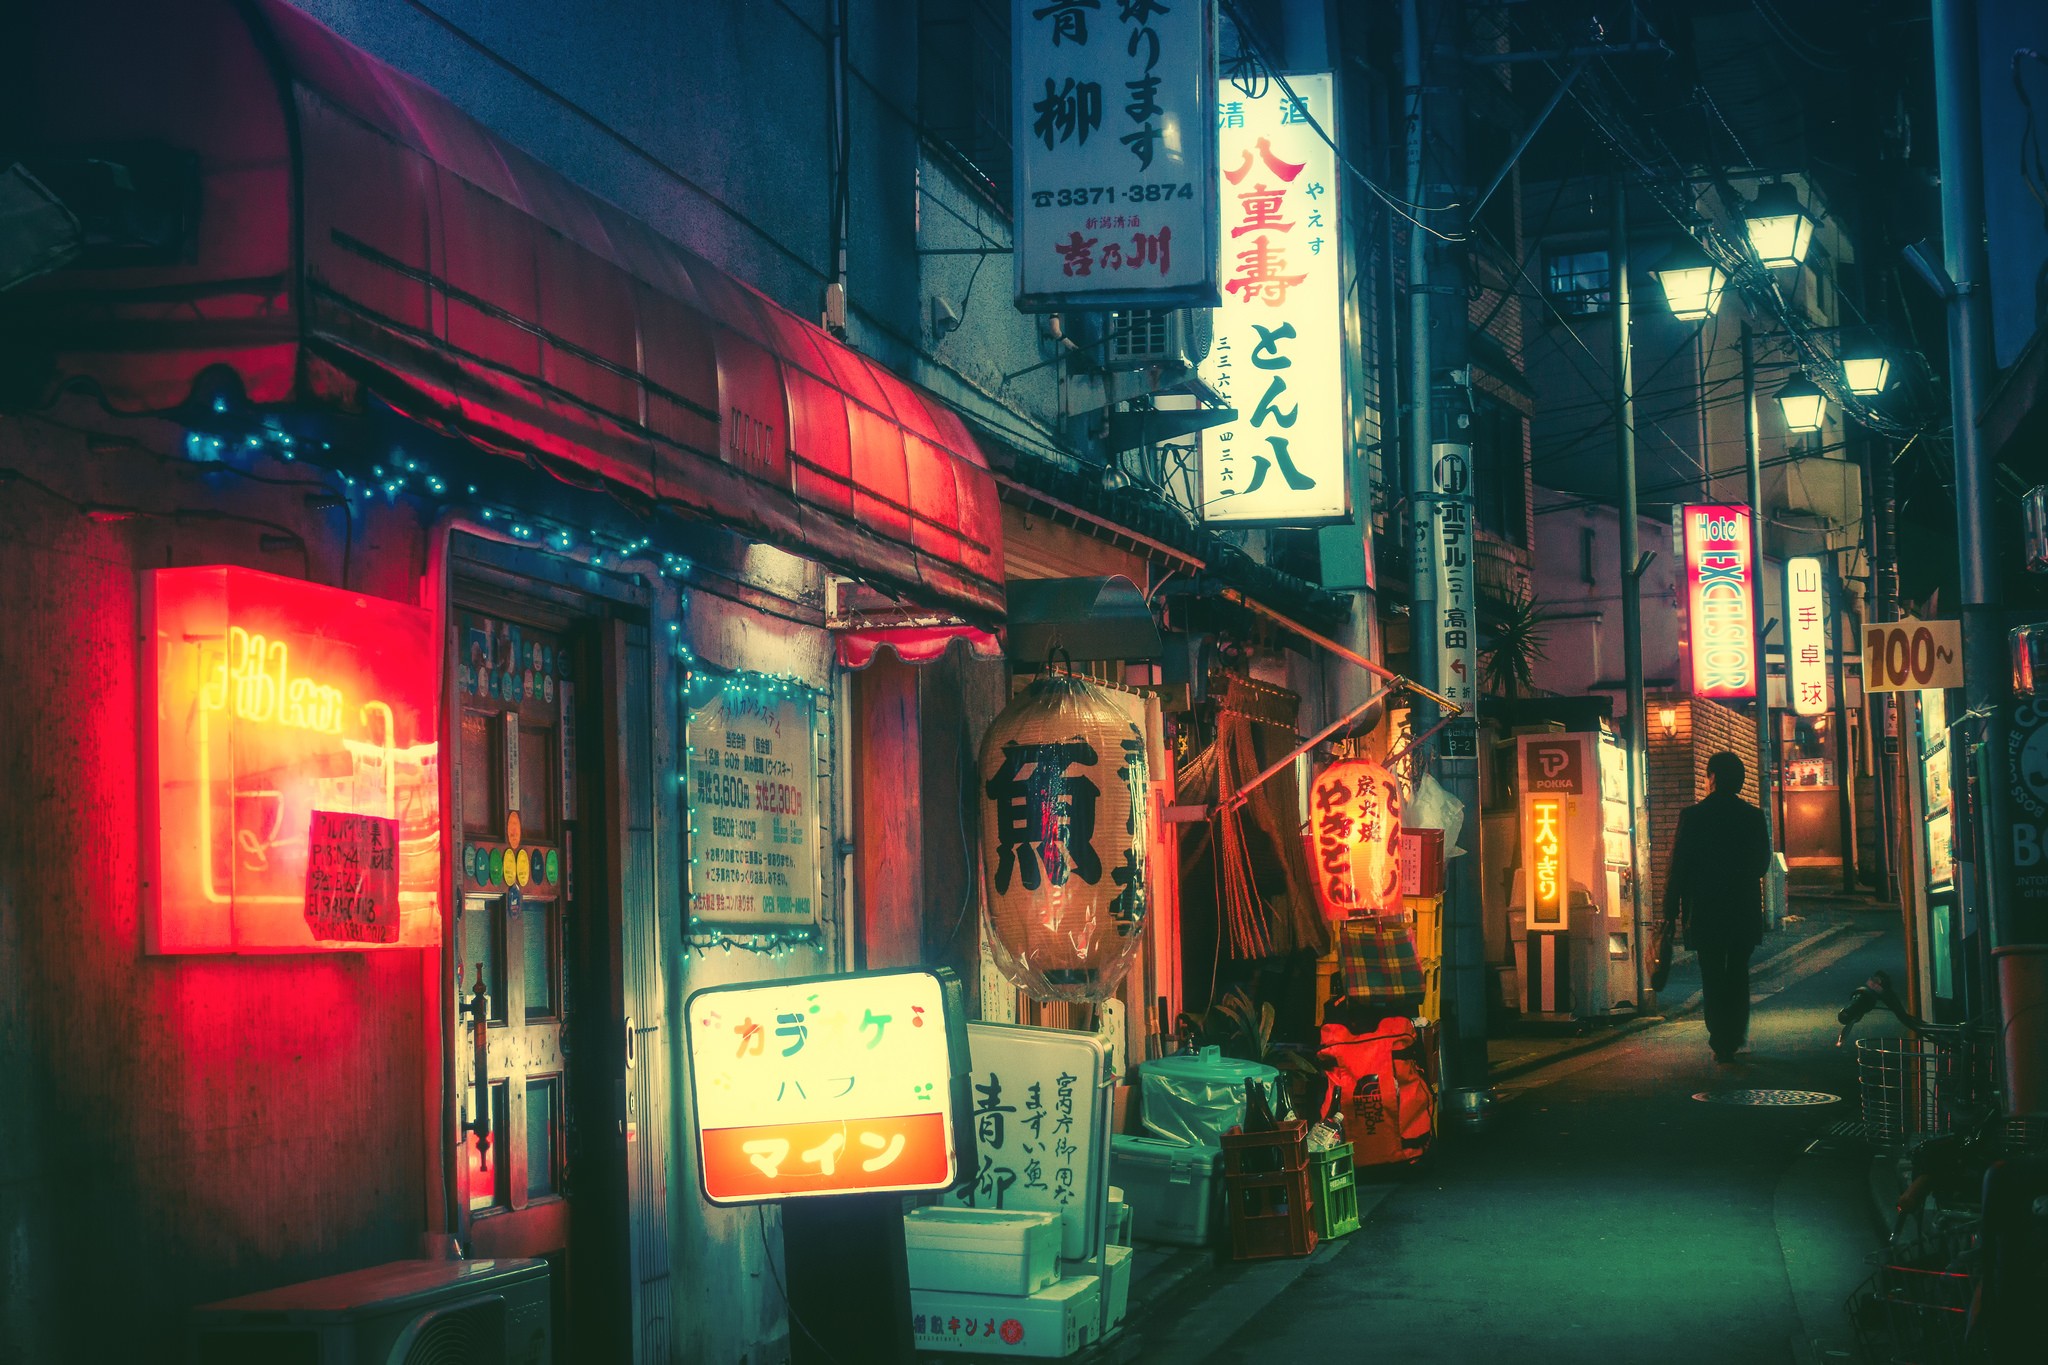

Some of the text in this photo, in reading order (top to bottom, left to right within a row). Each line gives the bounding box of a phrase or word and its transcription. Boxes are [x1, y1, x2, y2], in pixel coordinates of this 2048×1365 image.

[1218, 96, 1310, 129] 清酒
[1058, 182, 1193, 207] 3371-3874
[1223, 136, 1309, 307] 八重寿
[1306, 182, 1324, 255] やえす
[1055, 225, 1171, 278] 吉乃川
[1243, 321, 1316, 494] とん八
[1696, 513, 1743, 541] Hotel
[1441, 501, 1468, 649] ホテルニュー高田
[1699, 550, 1750, 689] EXCELSIOR
[1796, 569, 1823, 705] 山手卓球
[1445, 686, 1471, 699] 左折
[697, 770, 803, 817] 男性3,600円 女性2,300円
[1537, 779, 1573, 789] POKKA
[1317, 778, 1360, 904] やきとん
[2014, 822, 2048, 868] B
[734, 1008, 893, 1058] カラケ
[1353, 1096, 1364, 1118] THE
[1363, 1096, 1376, 1135] NORTH
[1372, 1095, 1384, 1123] FACE
[742, 1131, 906, 1178] マイン
[1020, 1082, 1048, 1191] まずい魚
